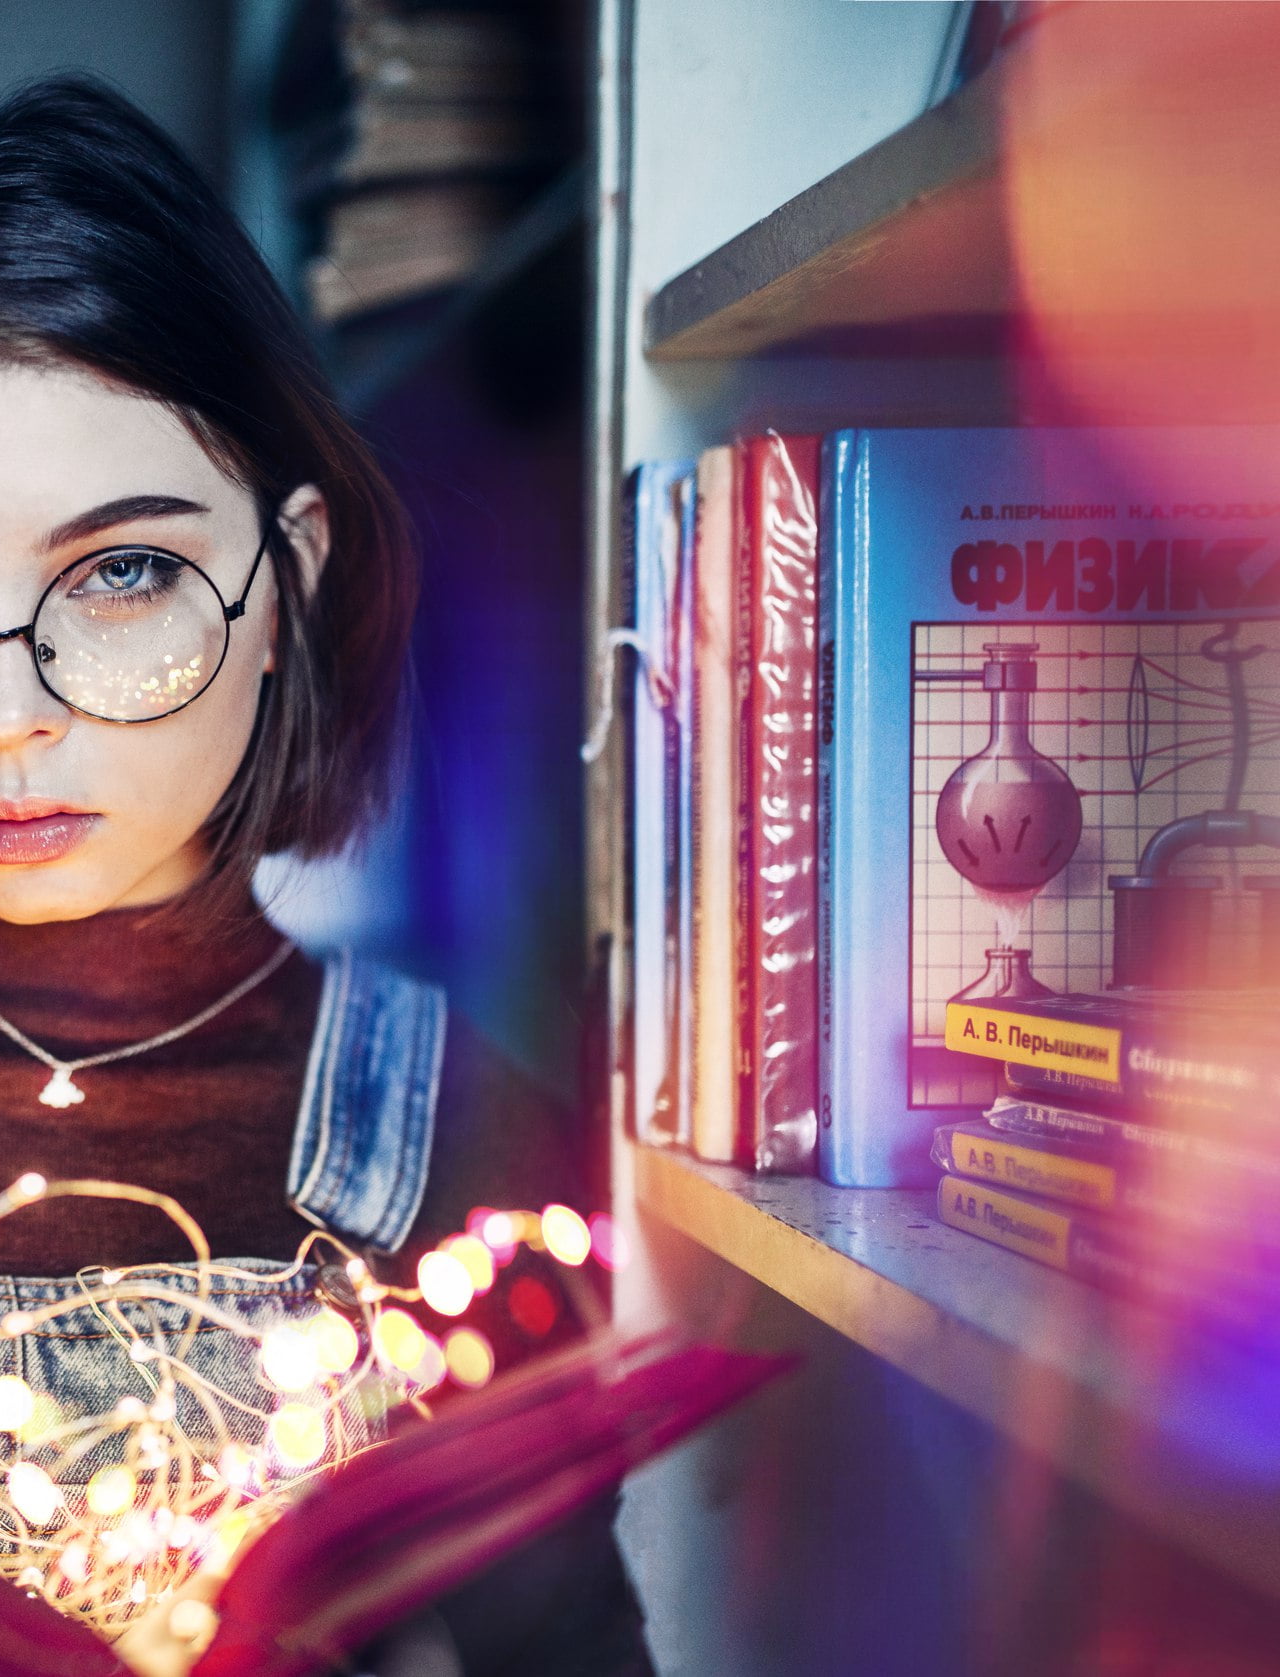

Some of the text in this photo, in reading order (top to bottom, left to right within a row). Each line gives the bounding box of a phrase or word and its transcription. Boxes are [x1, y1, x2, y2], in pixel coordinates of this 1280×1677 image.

[822, 640, 835, 745] ФИЗИКА
[963, 1017, 1109, 1064] А. В. Перышкин
